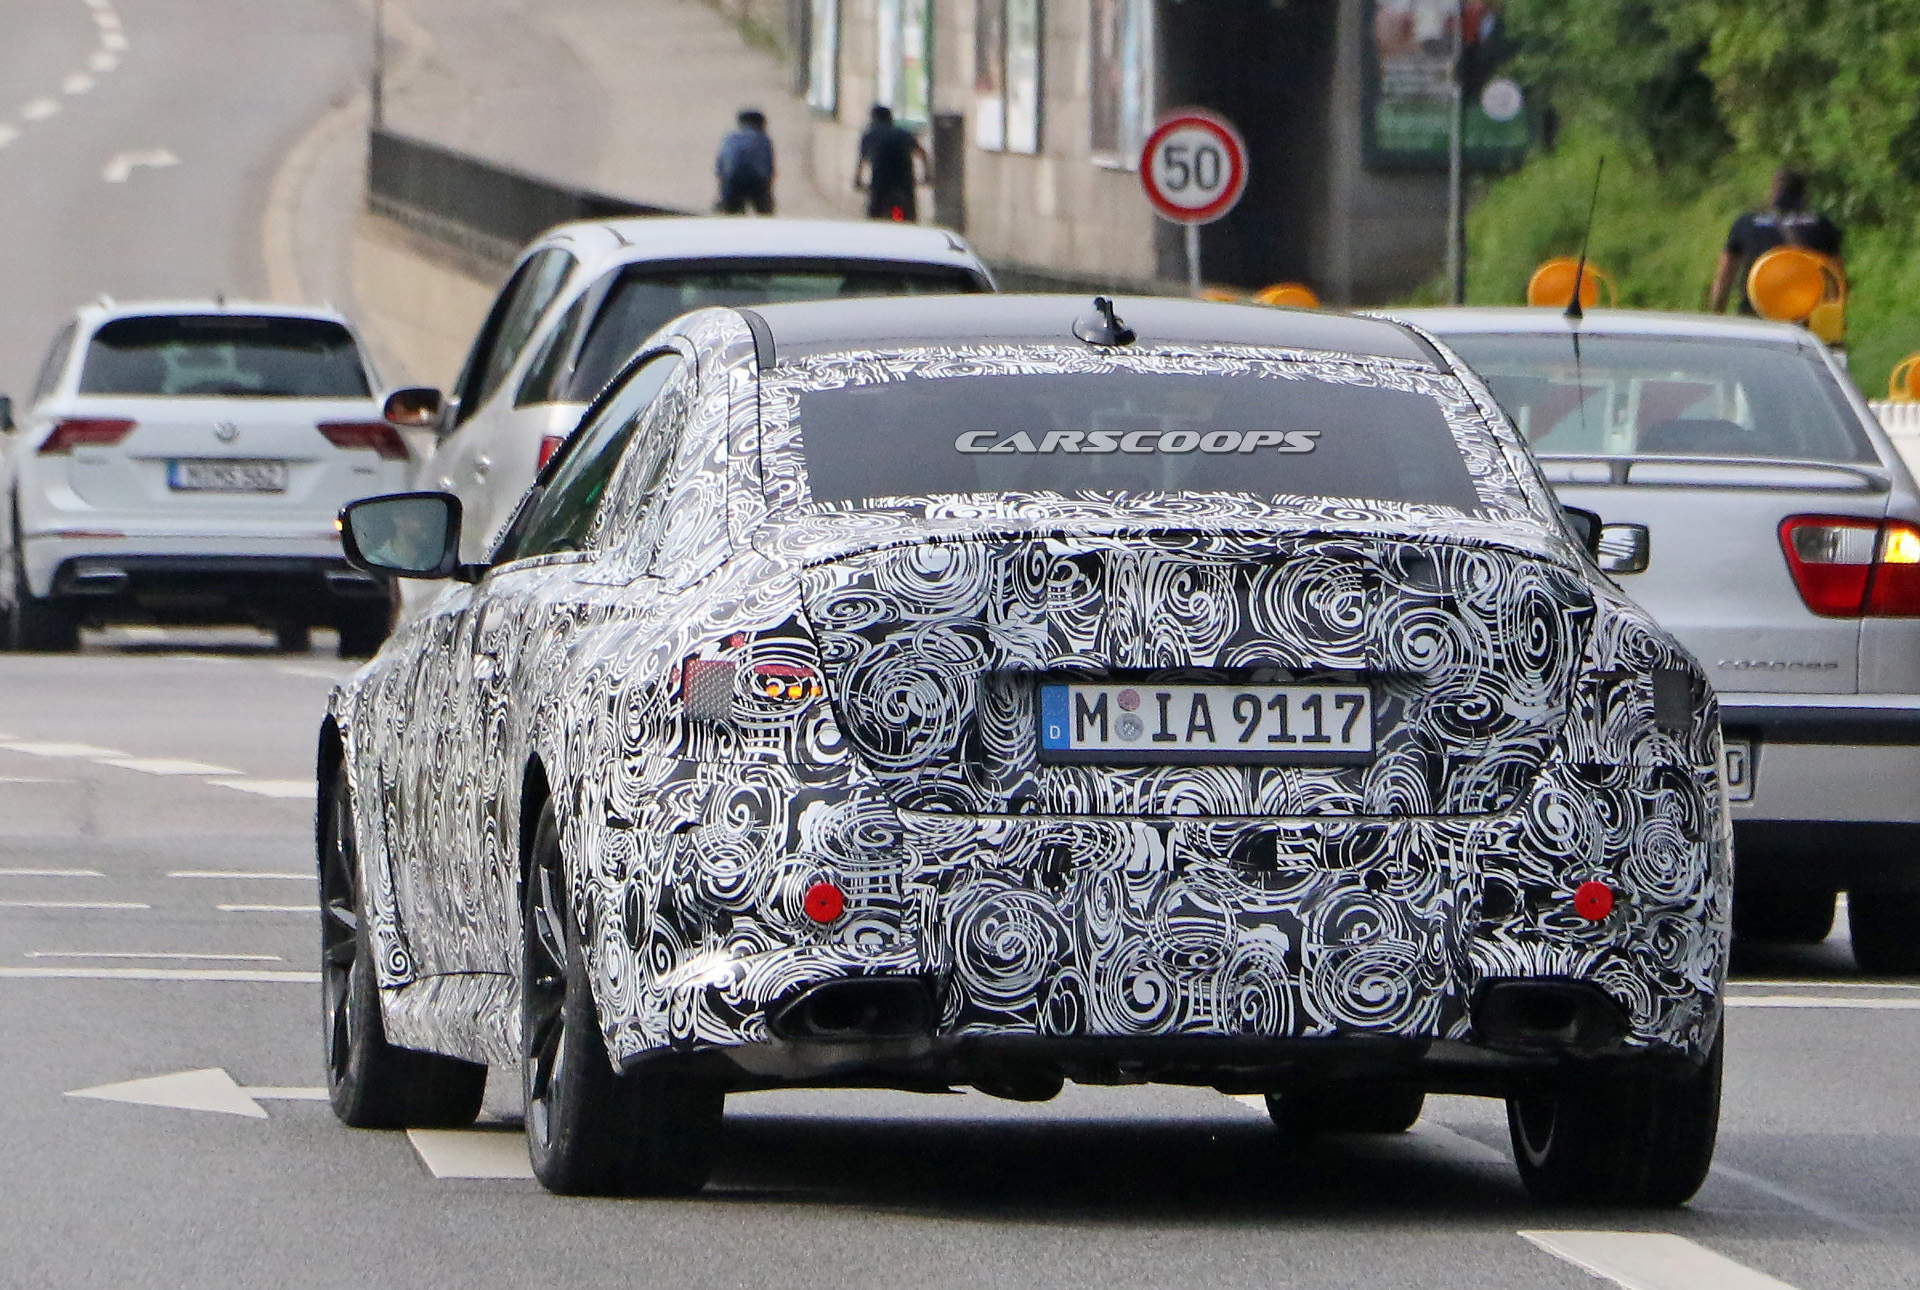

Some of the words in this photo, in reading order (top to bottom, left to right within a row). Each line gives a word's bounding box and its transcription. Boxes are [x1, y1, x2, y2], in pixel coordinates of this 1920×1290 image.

[1164, 145, 1220, 191] 50
[1050, 725, 1060, 739] D
[1075, 692, 1108, 742] M
[1152, 692, 1216, 743] IA
[1232, 692, 1365, 744] 9117
